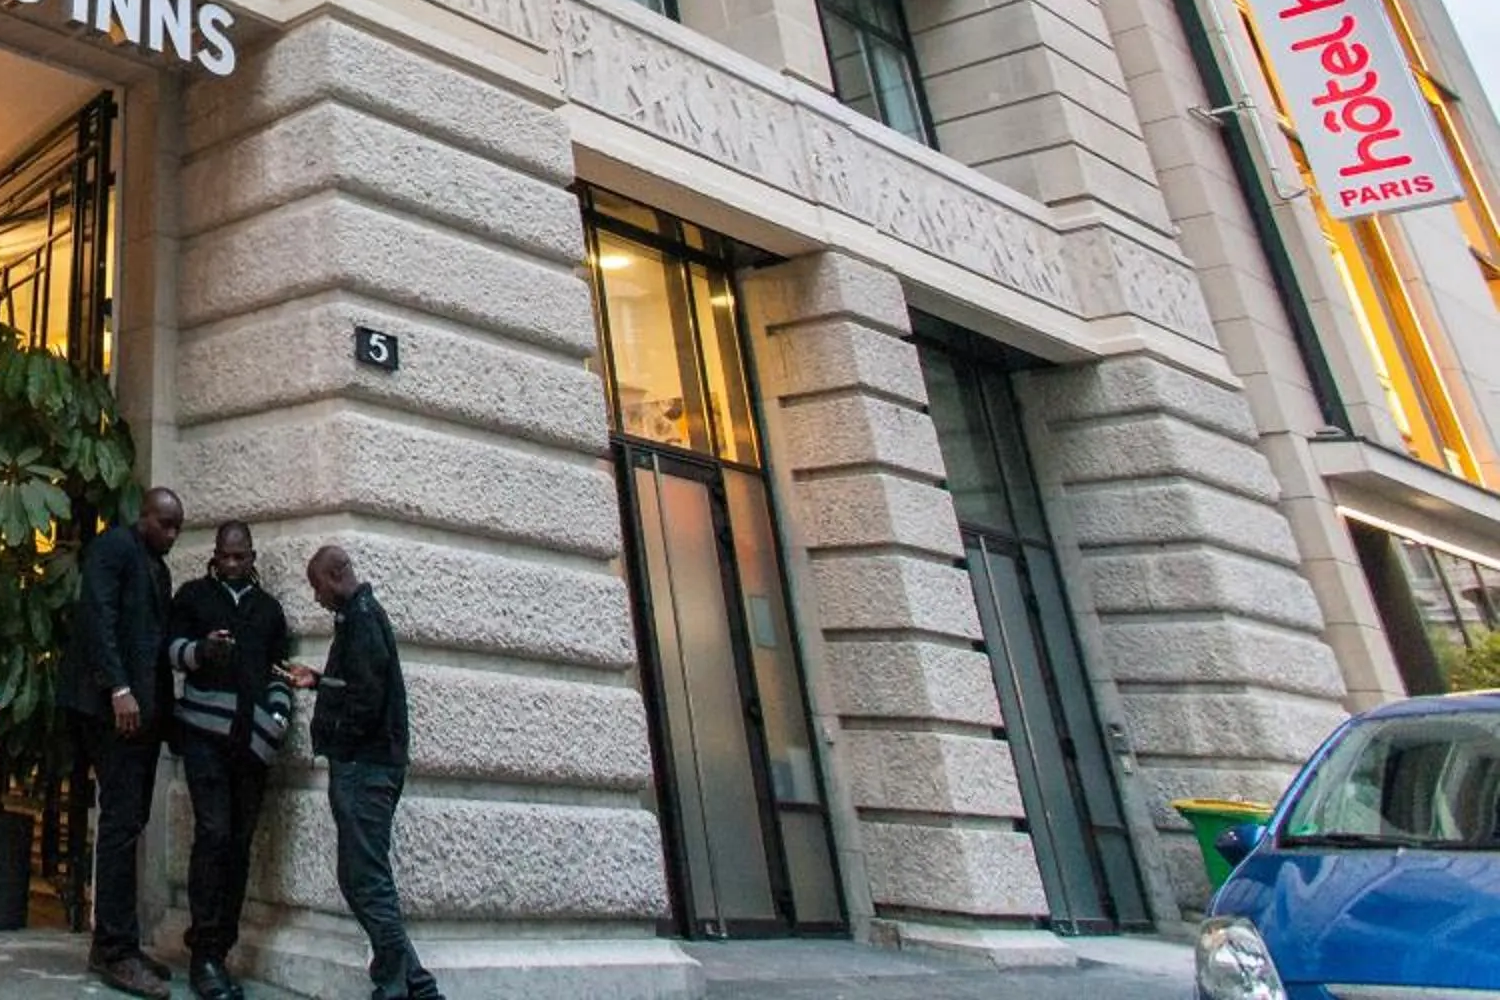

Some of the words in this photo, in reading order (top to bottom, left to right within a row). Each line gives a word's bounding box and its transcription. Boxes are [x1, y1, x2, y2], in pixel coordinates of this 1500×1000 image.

[1290, 15, 1413, 177] hôtel
[1339, 174, 1436, 208] PARIS
[369, 333, 389, 363] 5
